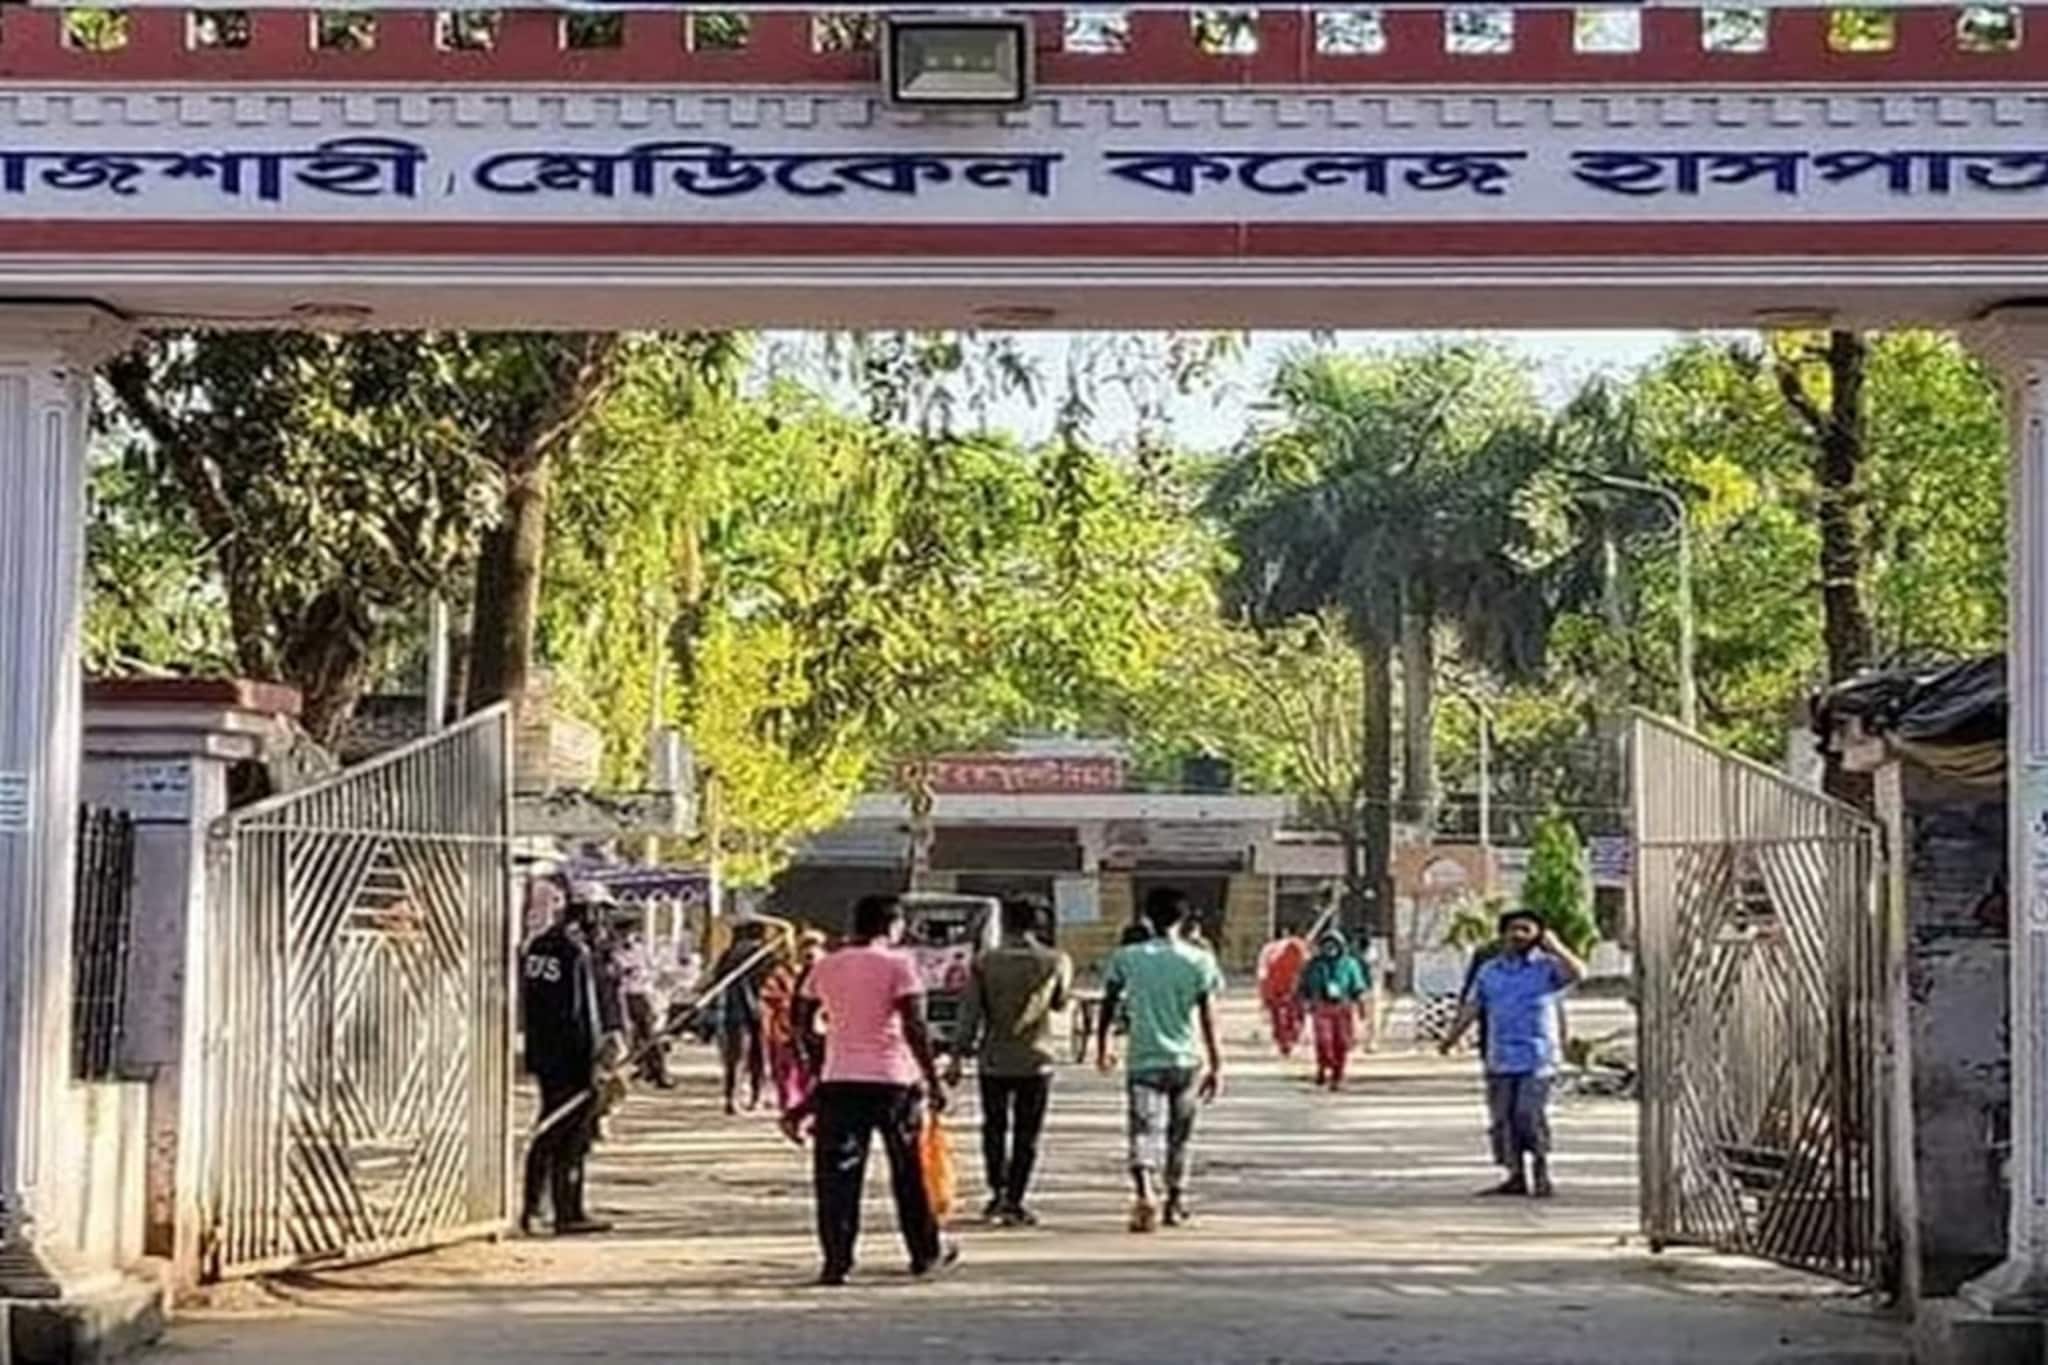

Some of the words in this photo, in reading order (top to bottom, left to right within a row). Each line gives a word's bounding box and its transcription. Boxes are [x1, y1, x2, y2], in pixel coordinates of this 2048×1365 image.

[0, 138, 427, 201] াজশাহী
[474, 140, 1064, 197] মেডিকেল
[1103, 150, 1527, 195] কলেজ
[1570, 150, 2048, 196] হাসপাত
